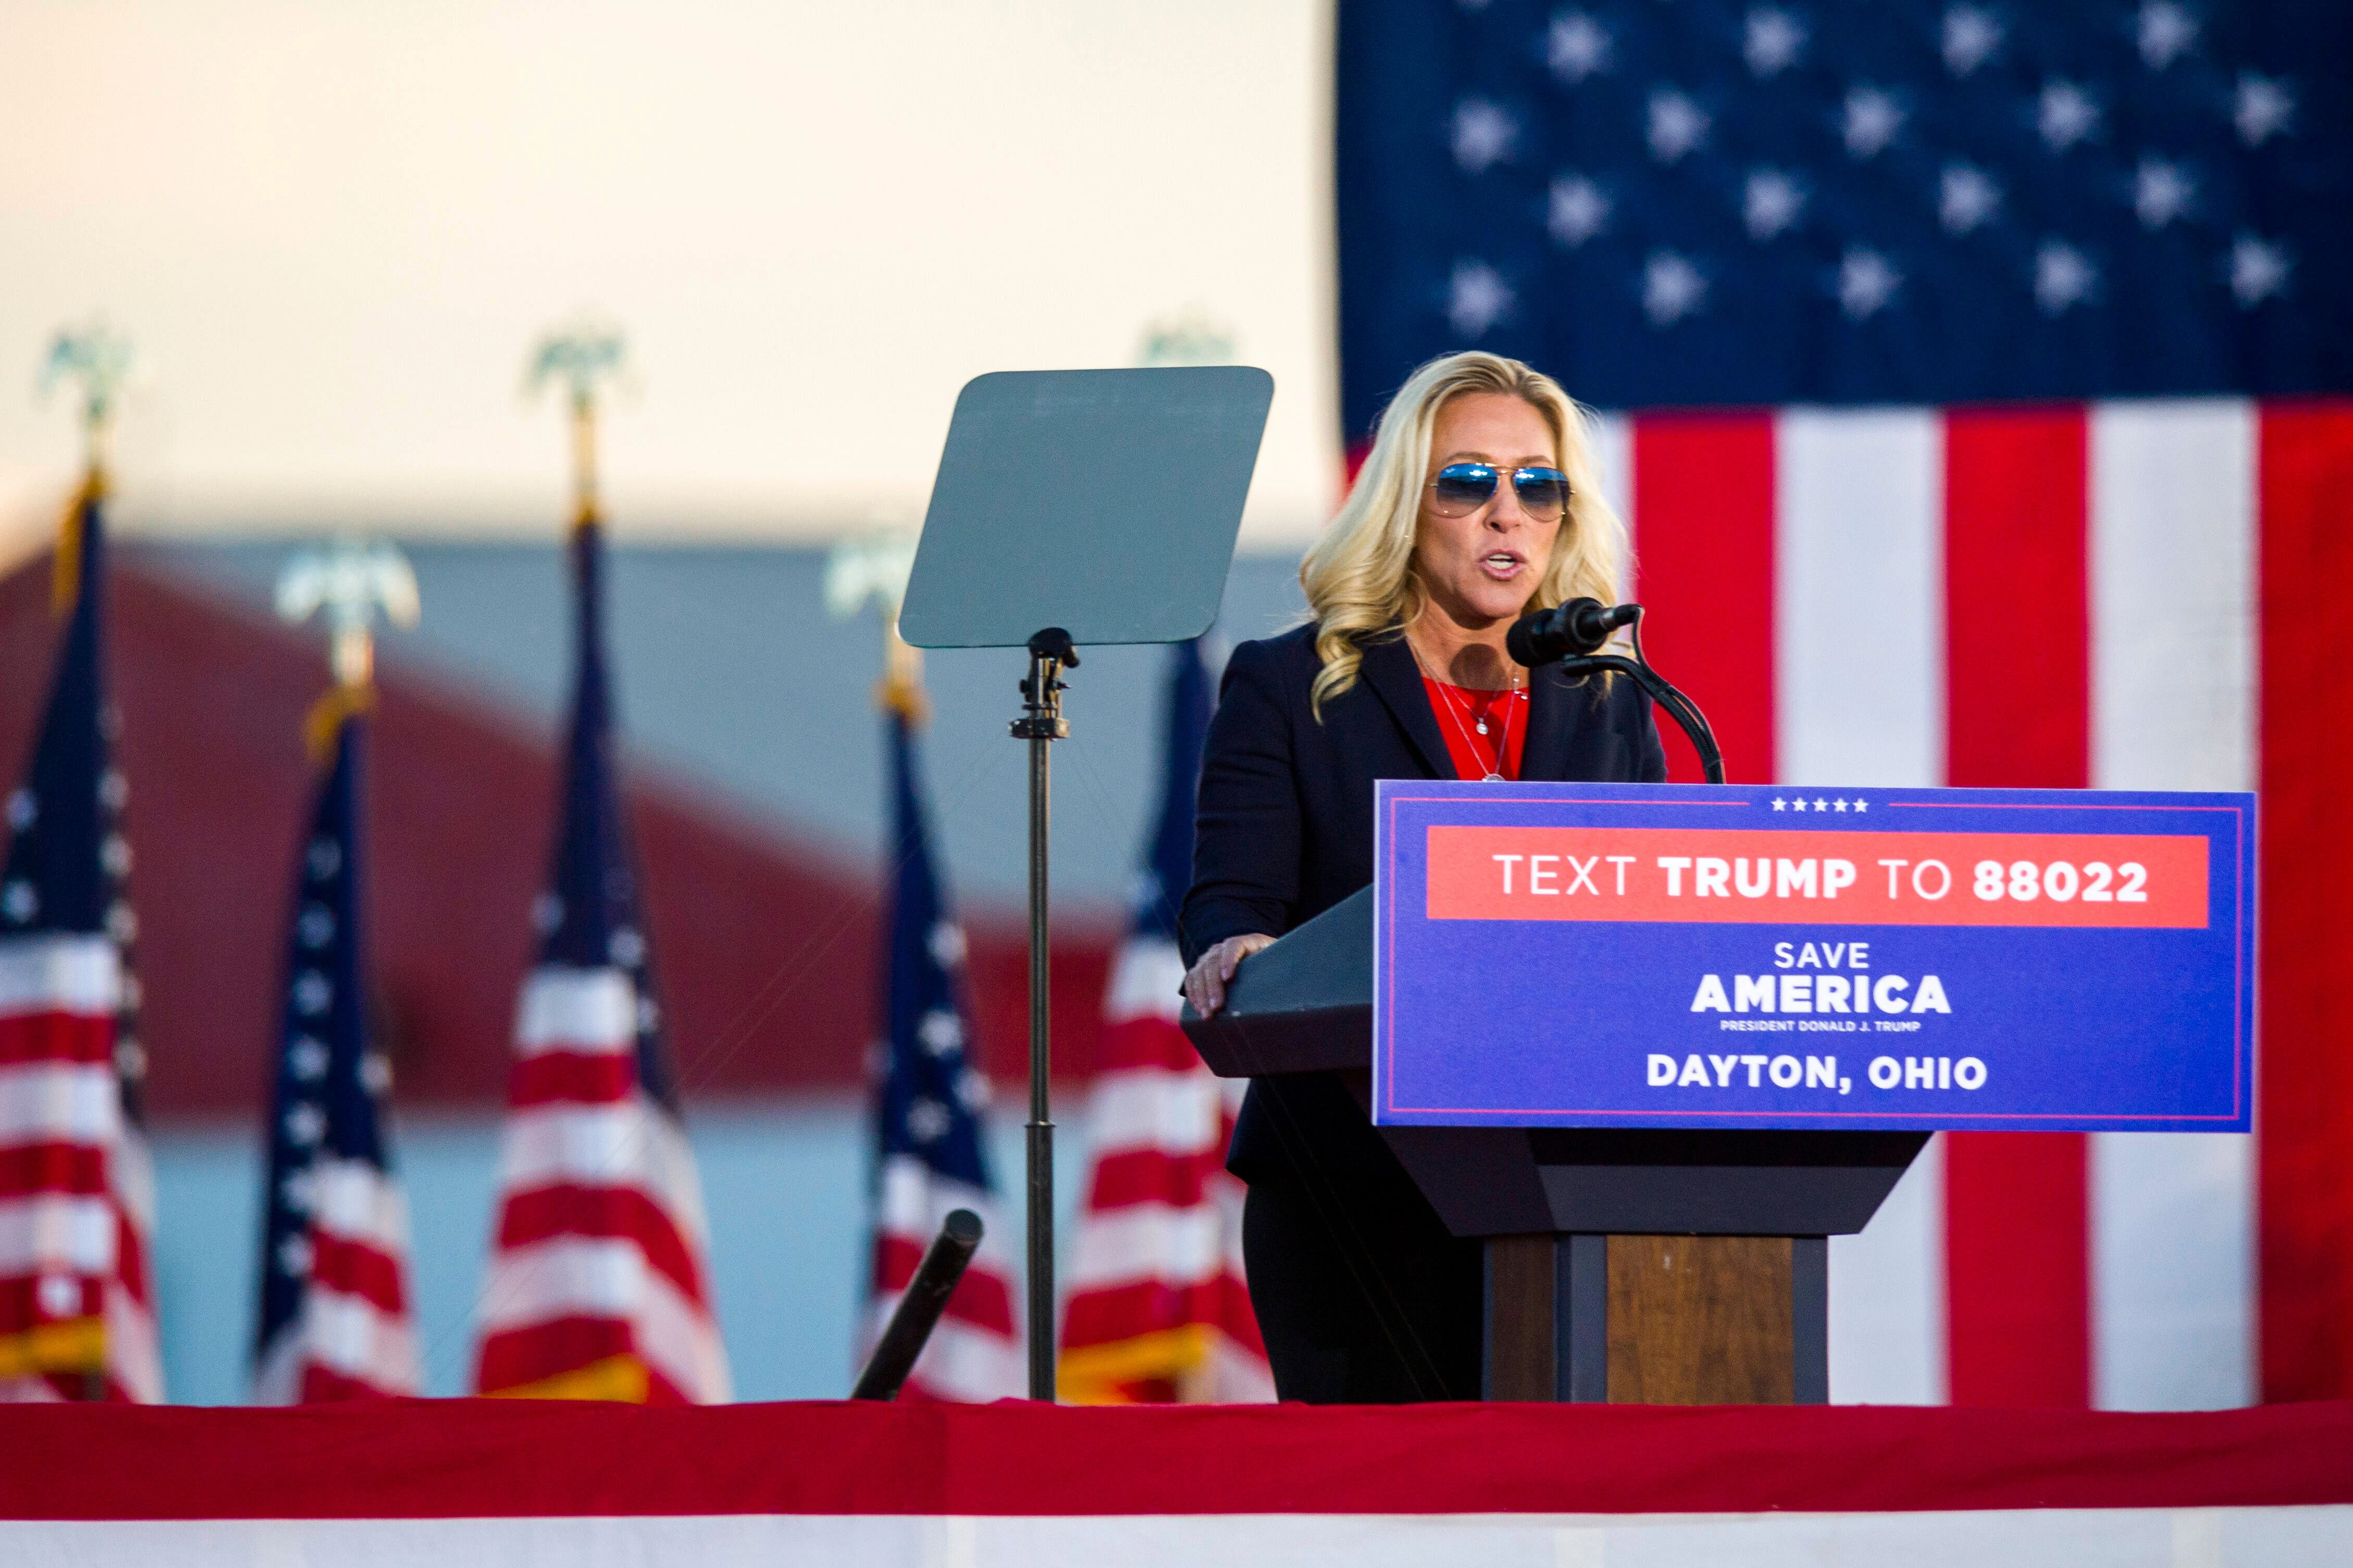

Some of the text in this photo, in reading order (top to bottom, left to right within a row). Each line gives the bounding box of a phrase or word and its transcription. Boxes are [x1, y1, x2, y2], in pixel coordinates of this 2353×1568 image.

[1492, 854, 2148, 902] TEXT TRUMP TO 88022
[1773, 942, 1870, 969] SAVE
[1690, 973, 1952, 1014] AMERICA
[1720, 1020, 1921, 1032] PRESIDENT DONALD J. TRUMP
[1646, 1053, 1988, 1095] DAYTON, OHIO
